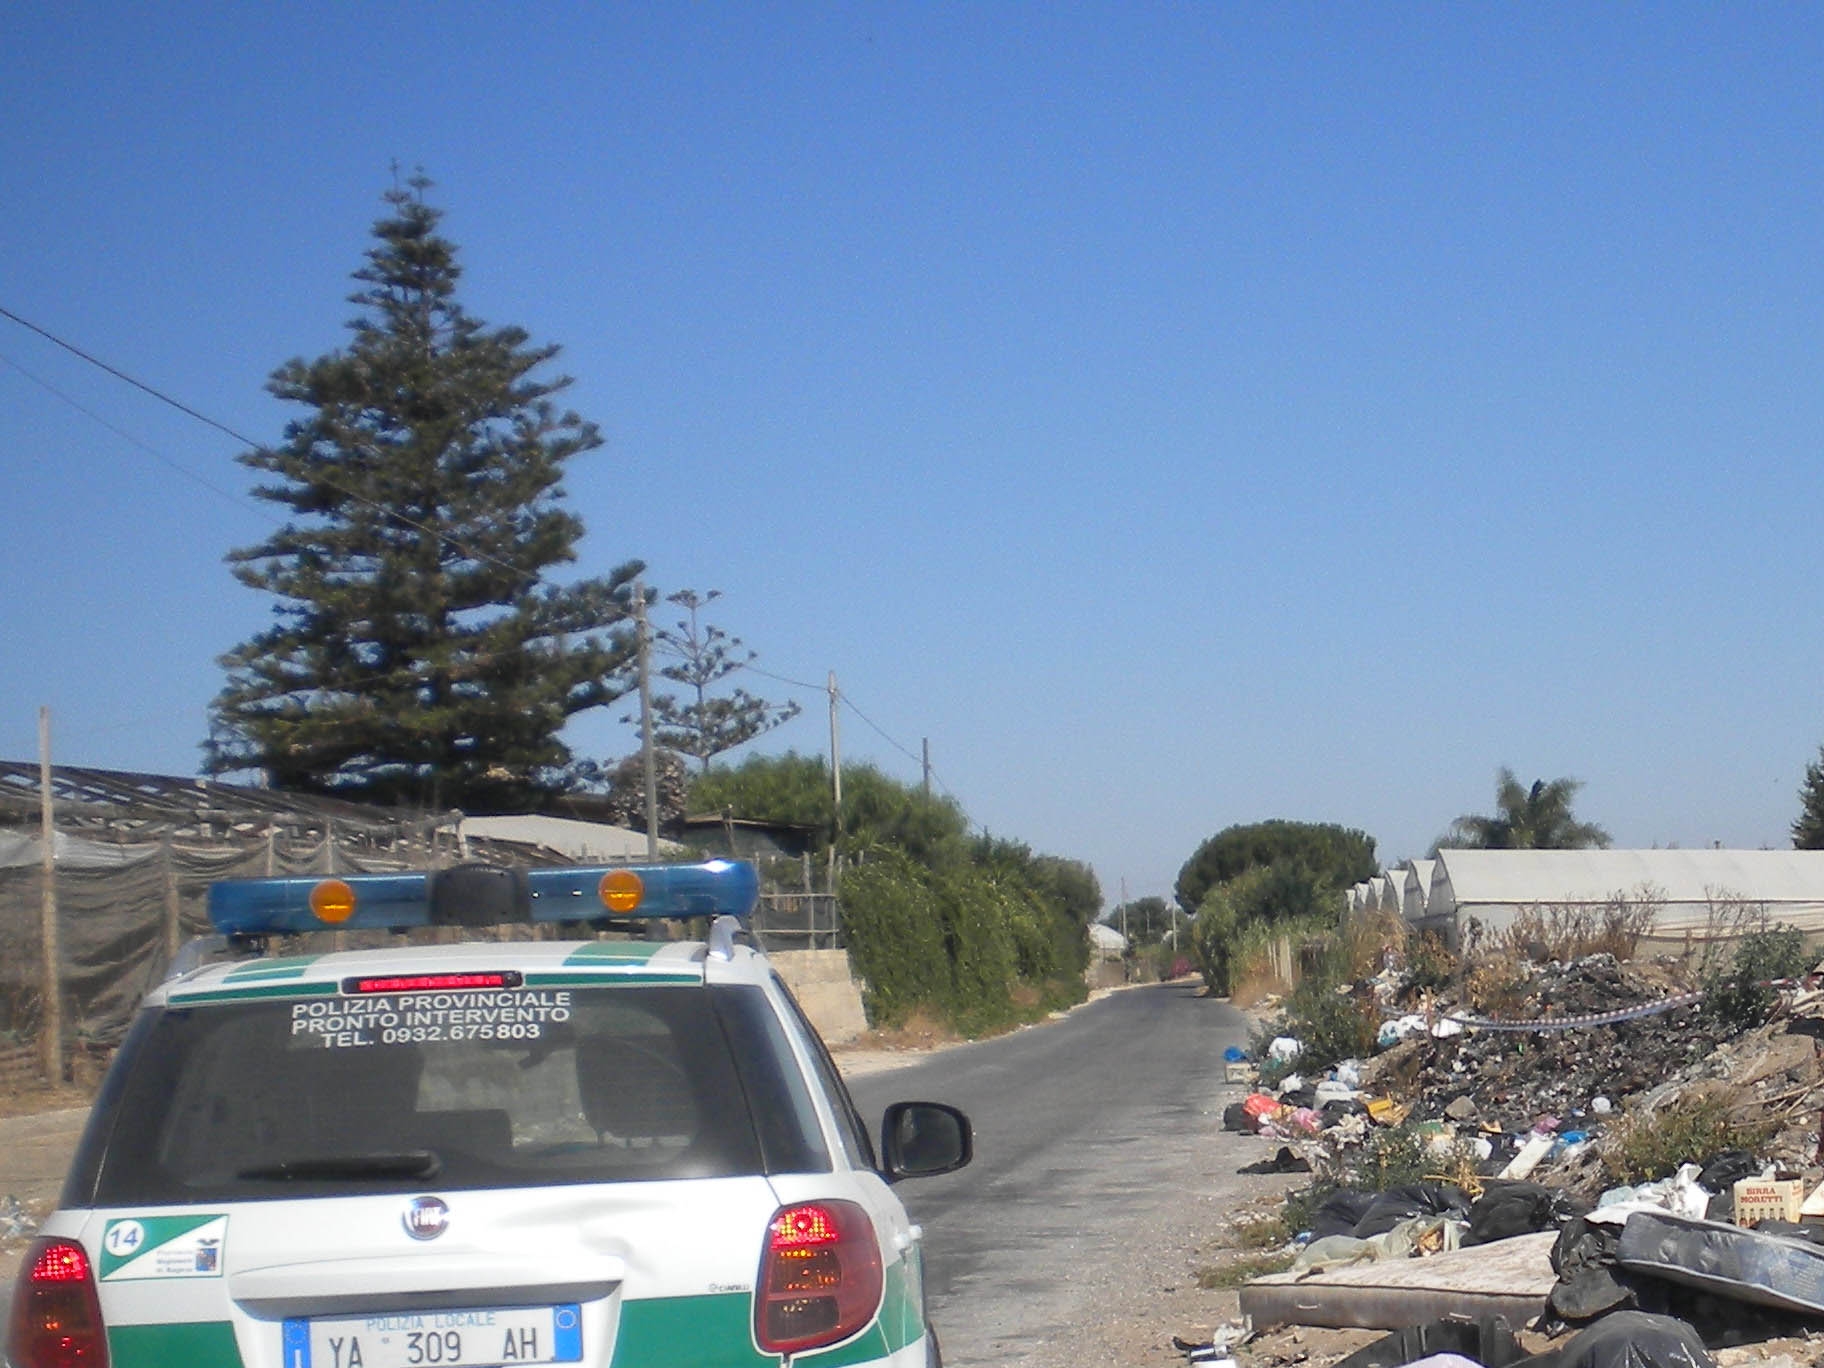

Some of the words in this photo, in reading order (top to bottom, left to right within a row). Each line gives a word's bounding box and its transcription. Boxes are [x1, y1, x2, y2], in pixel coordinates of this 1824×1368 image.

[292, 998, 391, 1018] POLIZIA
[399, 992, 571, 1011] PROVINCIALE
[291, 1013, 398, 1035] PRONTO
[406, 1007, 570, 1026] INTERVENTO
[321, 1032, 374, 1048] TEL.
[382, 1023, 540, 1044] 0932.675803
[1746, 1187, 1776, 1195] BIRRA
[110, 1227, 138, 1248] 14
[366, 1316, 424, 1331] POLIZIA
[434, 1311, 496, 1328] LOCALE
[329, 1337, 363, 1368] YA
[406, 1331, 462, 1364] 309
[503, 1328, 537, 1360] AH
